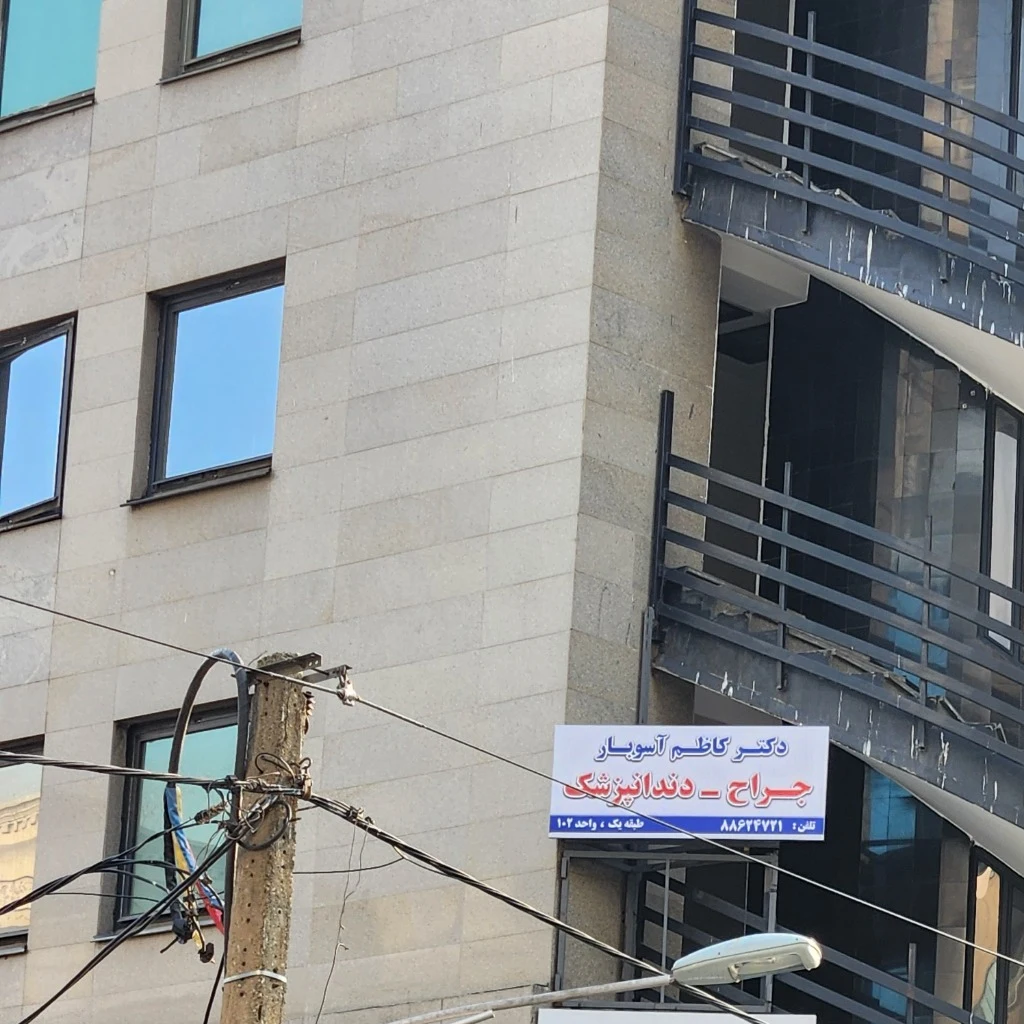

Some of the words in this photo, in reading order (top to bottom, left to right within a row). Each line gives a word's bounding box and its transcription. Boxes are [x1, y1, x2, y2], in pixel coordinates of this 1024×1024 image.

[670, 736, 731, 761] کاظم
[731, 736, 788, 761] دکتر
[563, 772, 695, 808] دندانپزشک
[727, 772, 813, 807] جراح
[574, 818, 597, 831] واحد
[608, 818, 622, 831] یک
[624, 818, 644, 831] طبقه
